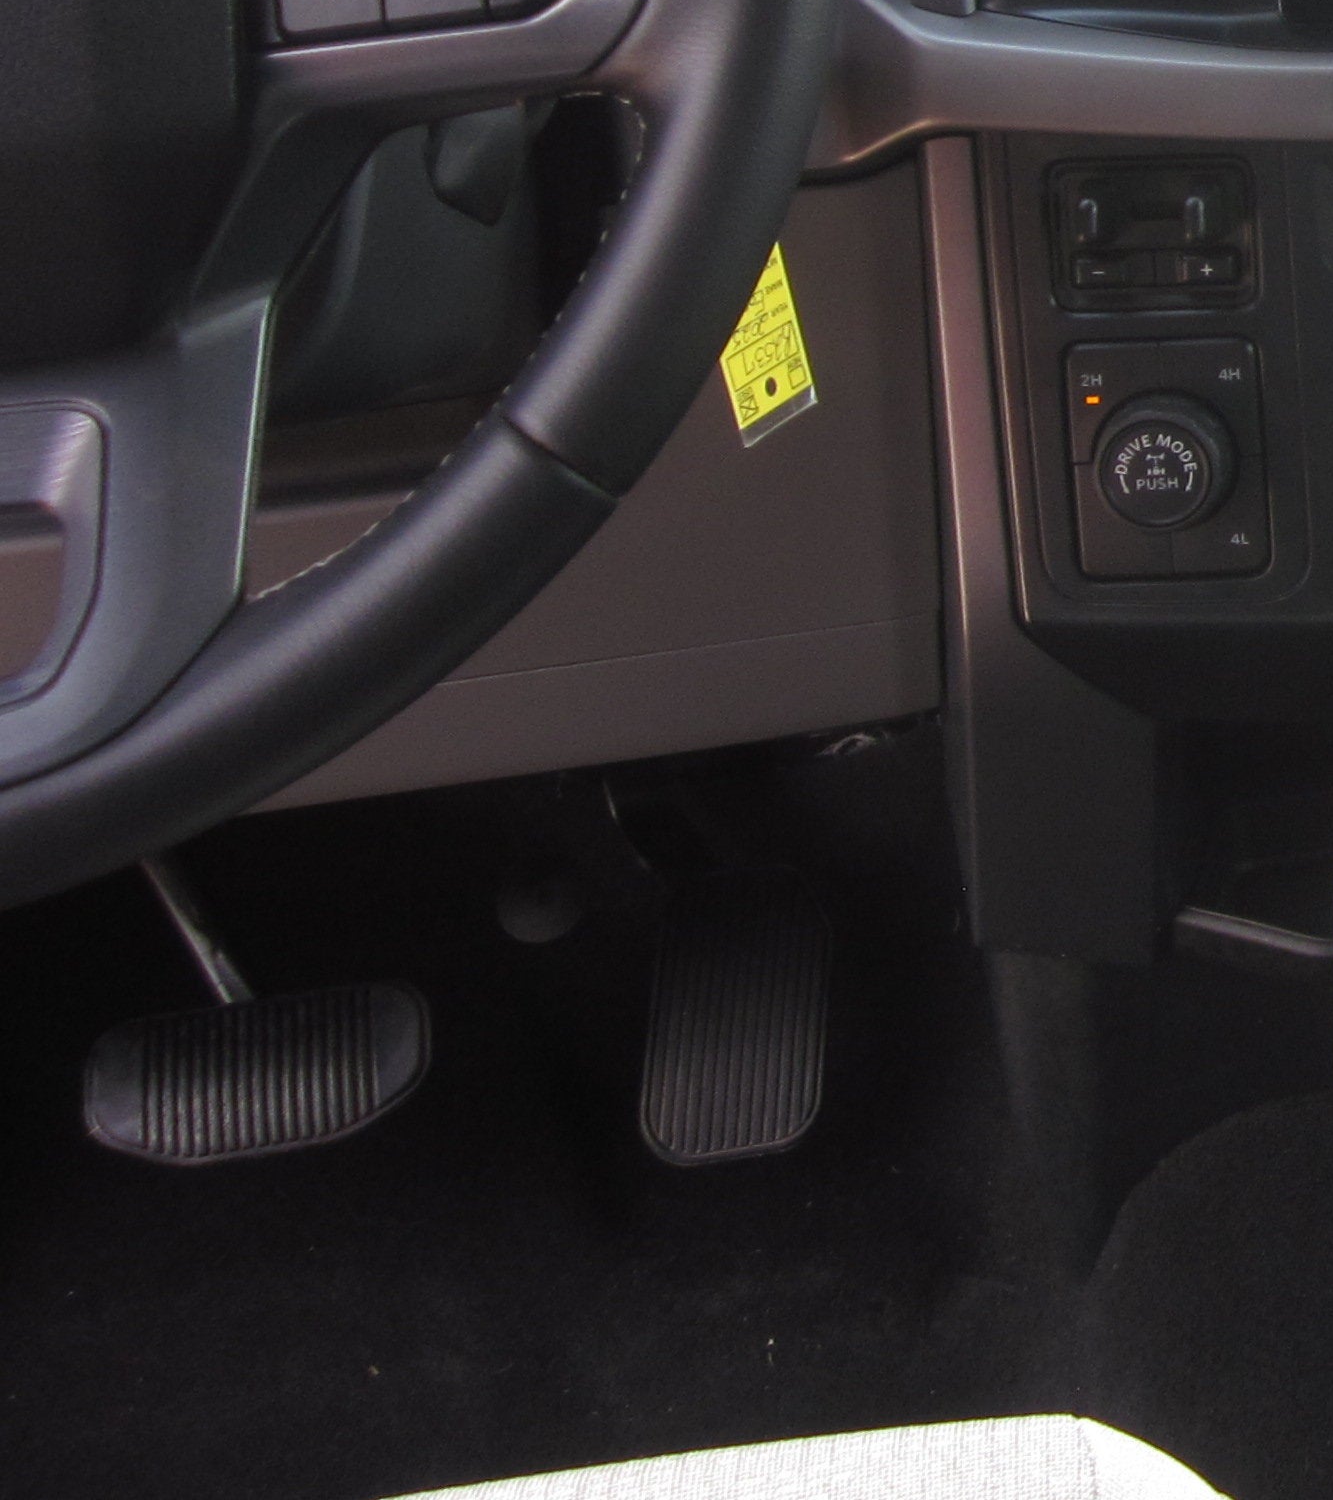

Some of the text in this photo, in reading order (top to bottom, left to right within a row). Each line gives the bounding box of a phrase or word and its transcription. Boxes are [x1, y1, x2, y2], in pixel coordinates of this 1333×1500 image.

[1080, 373, 1103, 387] 2H
[1217, 368, 1241, 381] 4H
[1114, 433, 1198, 475] DRIVE MODE
[1135, 476, 1179, 491] PUSH
[1230, 533, 1250, 546] 4L
